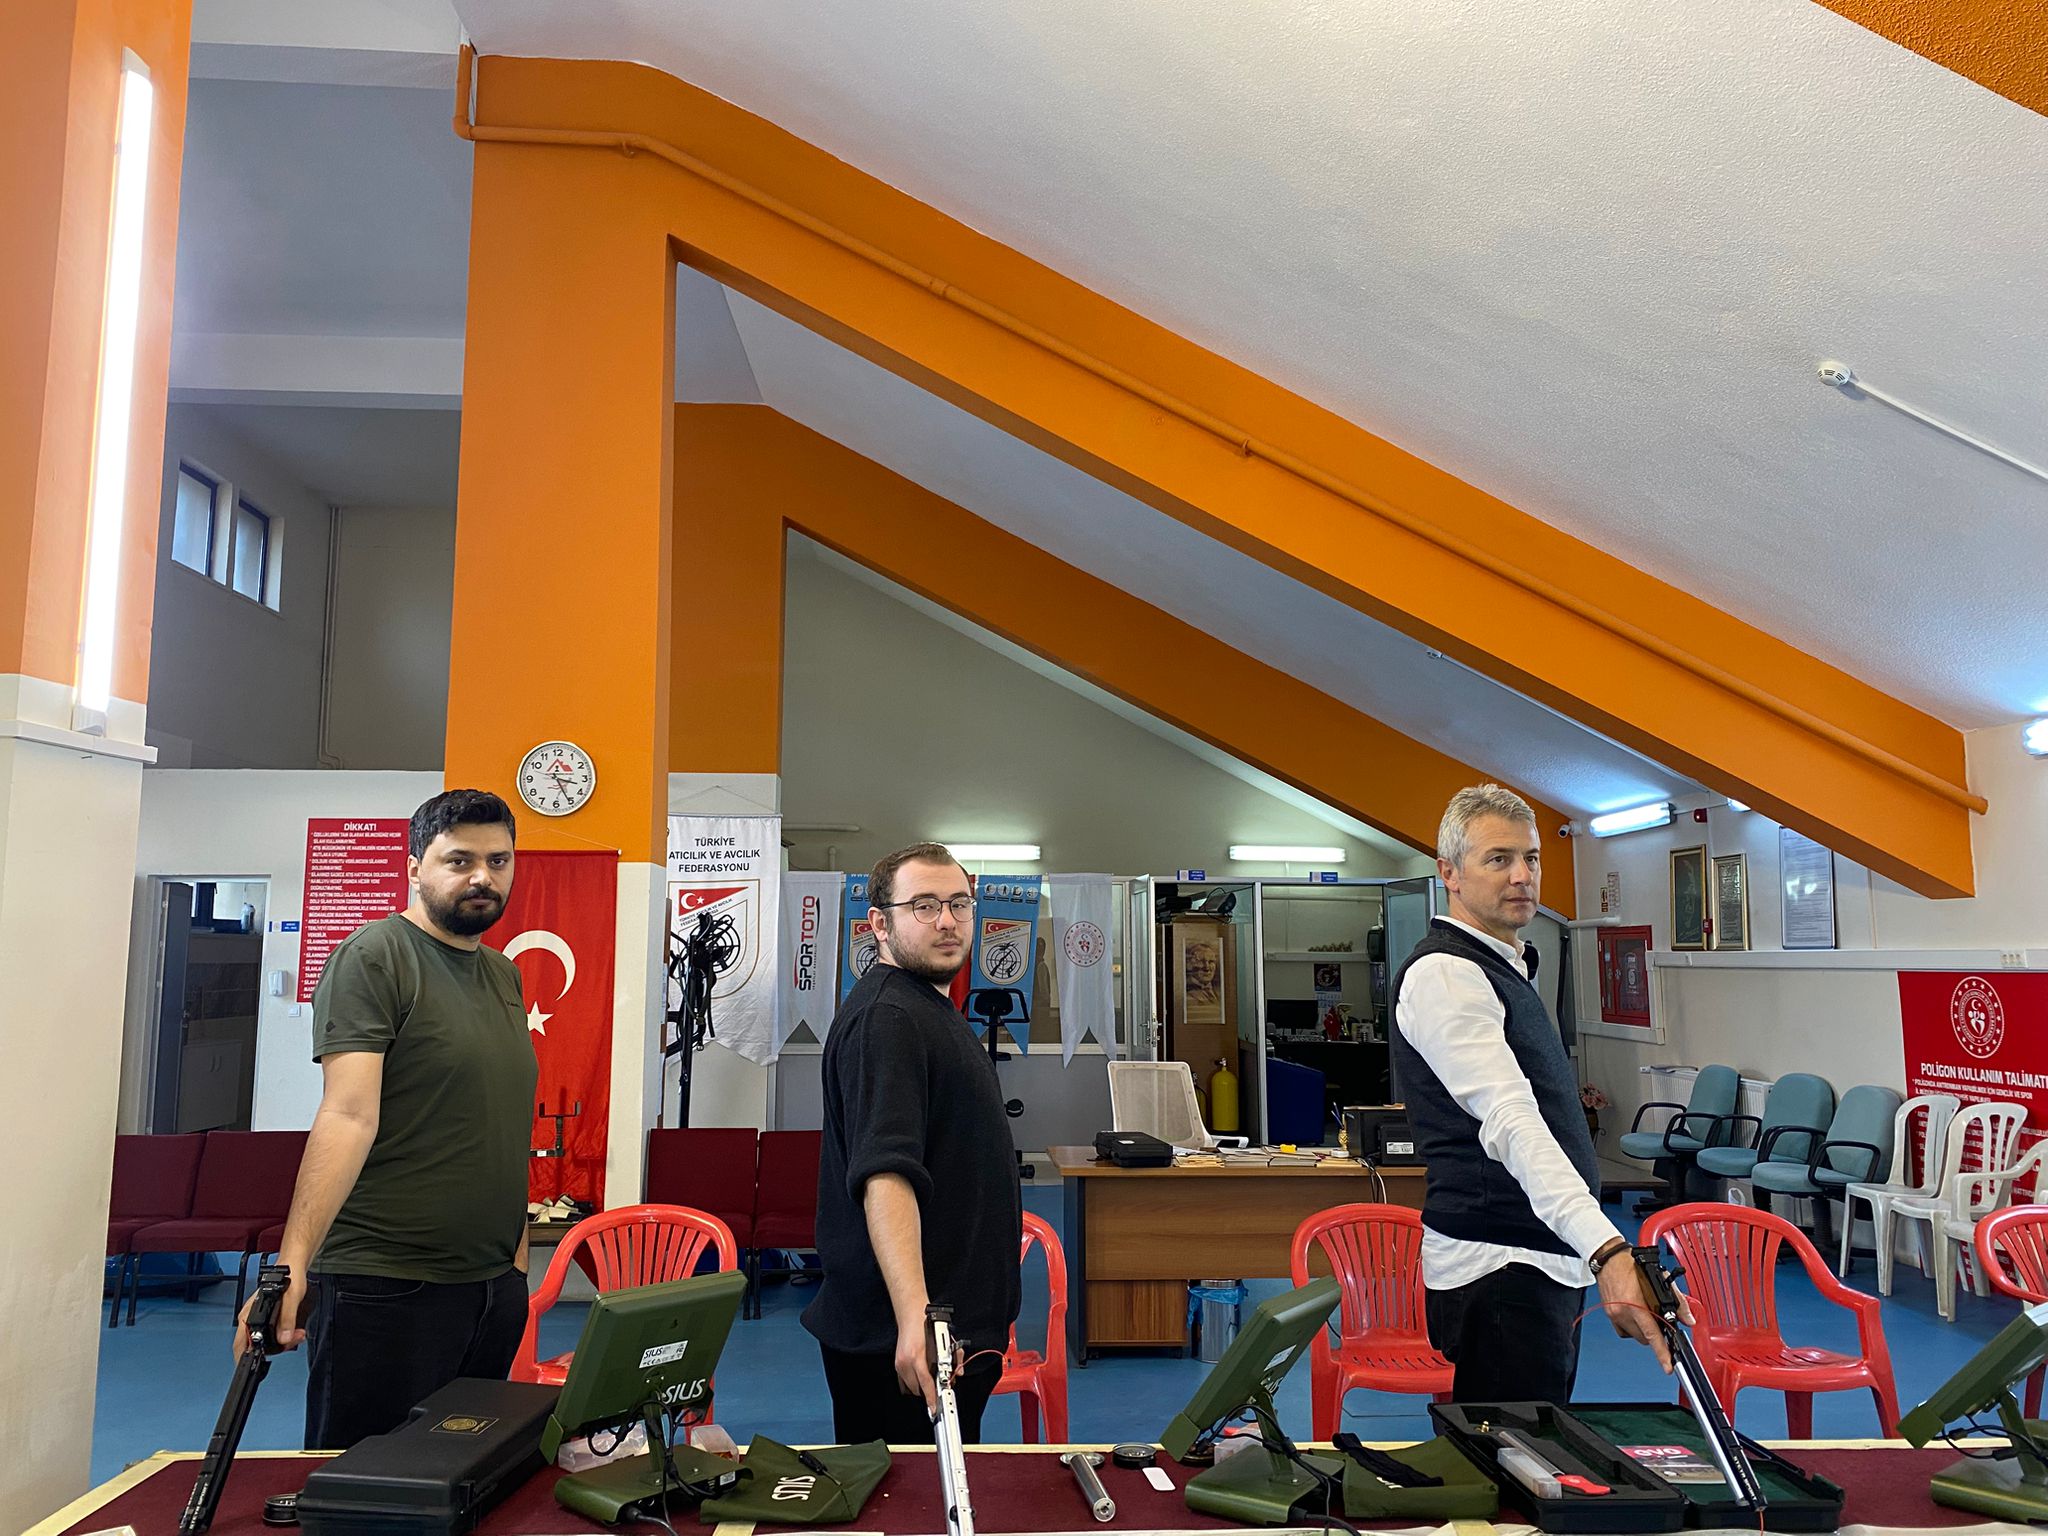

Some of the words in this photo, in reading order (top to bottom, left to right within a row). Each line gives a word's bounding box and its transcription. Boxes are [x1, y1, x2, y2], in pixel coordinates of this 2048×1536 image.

[526, 775, 533, 783] 9
[530, 788, 537, 796] 8
[539, 797, 545, 805] 7
[567, 797, 574, 805] 5
[695, 836, 735, 846] TÜRKİYE
[669, 851, 707, 859] ATICILIK
[710, 850, 722, 859] VE
[724, 849, 760, 858] AVCILIK
[679, 863, 749, 872] FEDERASYONU
[1921, 1061, 1956, 1079] POLİGON
[1957, 1067, 2003, 1085] KULLANIM
[644, 1348, 663, 1359] SIUS
[663, 1379, 706, 1404] SIUS
[771, 1475, 816, 1500] SIUS
